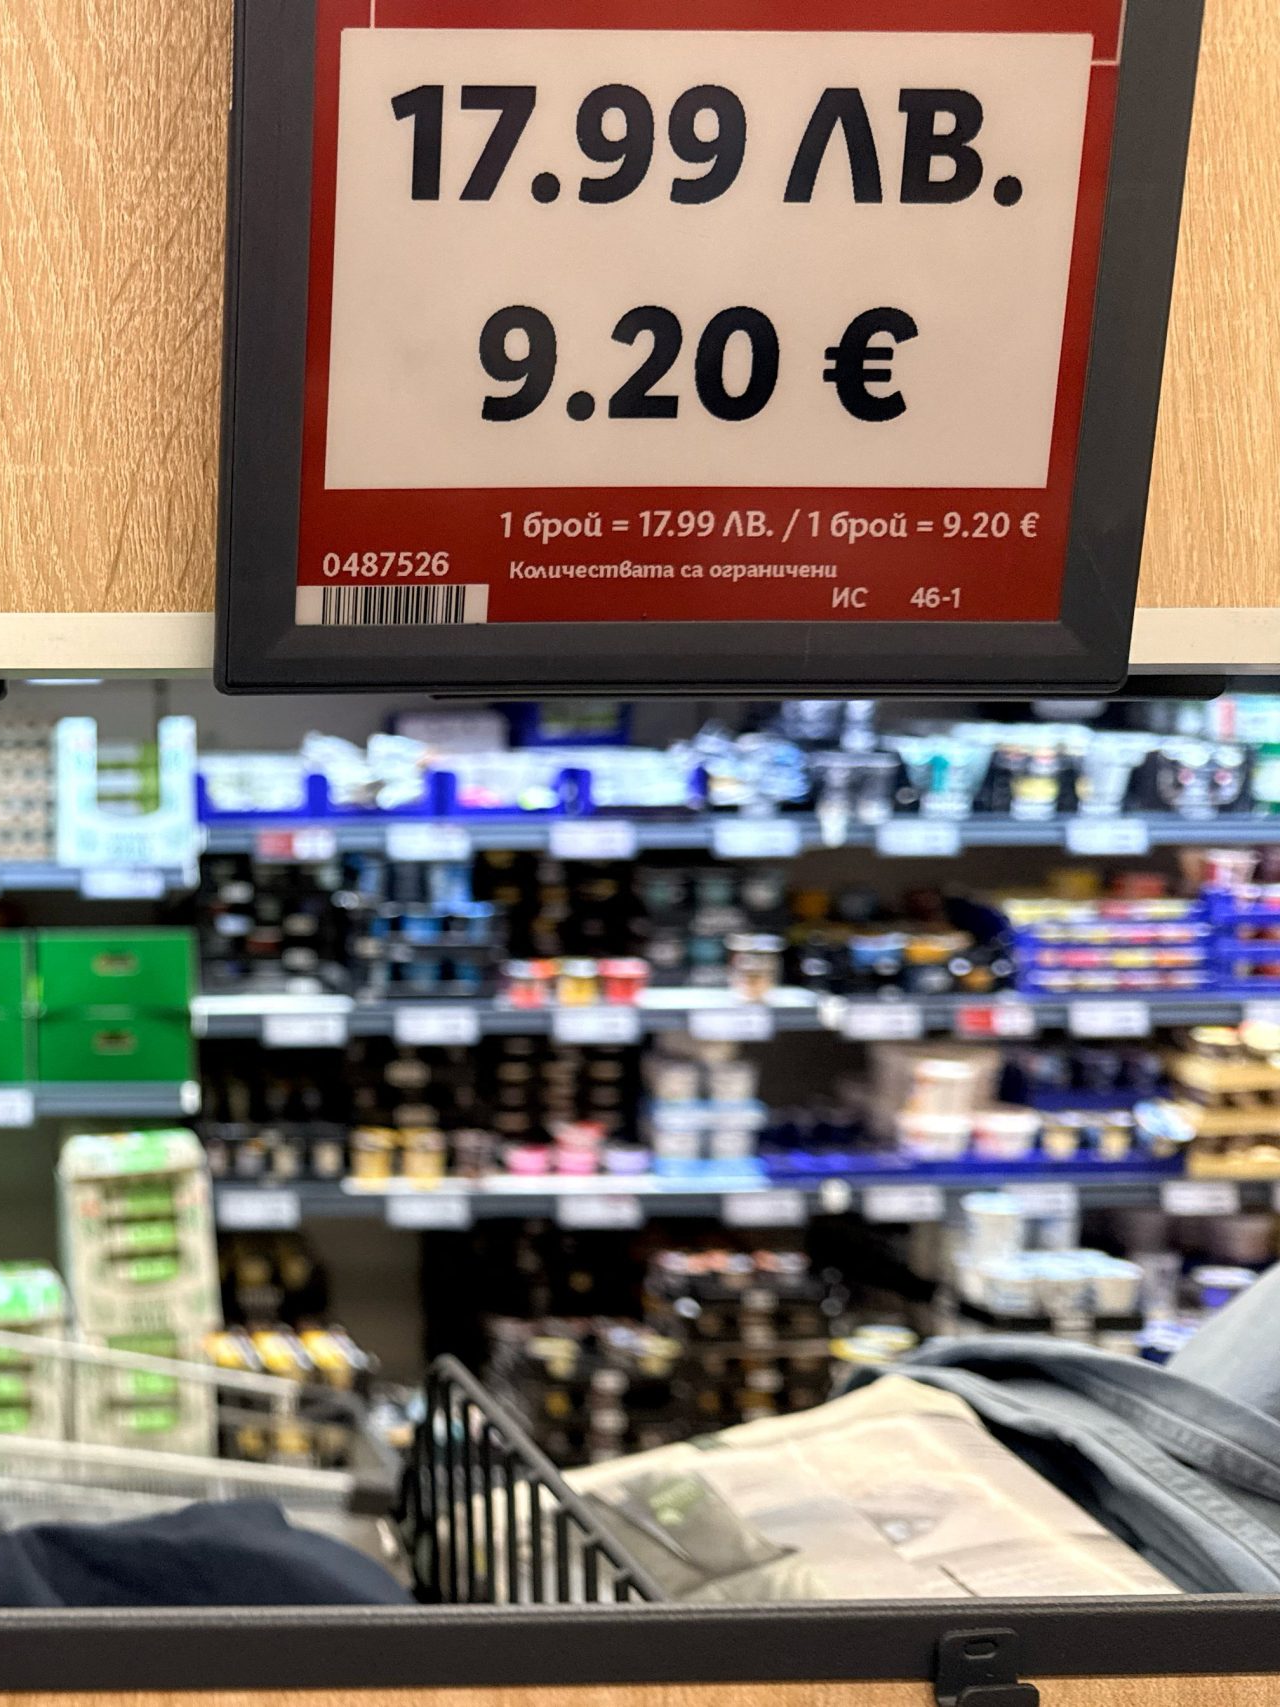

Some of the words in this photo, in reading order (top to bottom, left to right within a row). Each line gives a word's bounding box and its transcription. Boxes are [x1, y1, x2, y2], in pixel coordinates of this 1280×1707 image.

[390, 83, 747, 205] 17.99
[783, 87, 1023, 207] ЛВ.
[478, 304, 781, 422] 9.20
[822, 306, 919, 423] €
[501, 512, 512, 538] 1
[523, 511, 602, 544] брой
[612, 520, 629, 531] =
[639, 510, 715, 537] 17.99
[722, 510, 773, 537] ЛВ.
[782, 508, 800, 543] /
[808, 511, 820, 537] 1
[830, 511, 907, 544] брой
[917, 521, 933, 532] =
[943, 511, 1010, 538] 9.20
[1020, 512, 1040, 538] €
[323, 551, 449, 577] 0487526
[510, 560, 674, 579] Количествата
[681, 565, 703, 578] са
[709, 564, 837, 582] ограничени
[832, 587, 868, 608] ИС
[910, 587, 960, 608] 46-1
